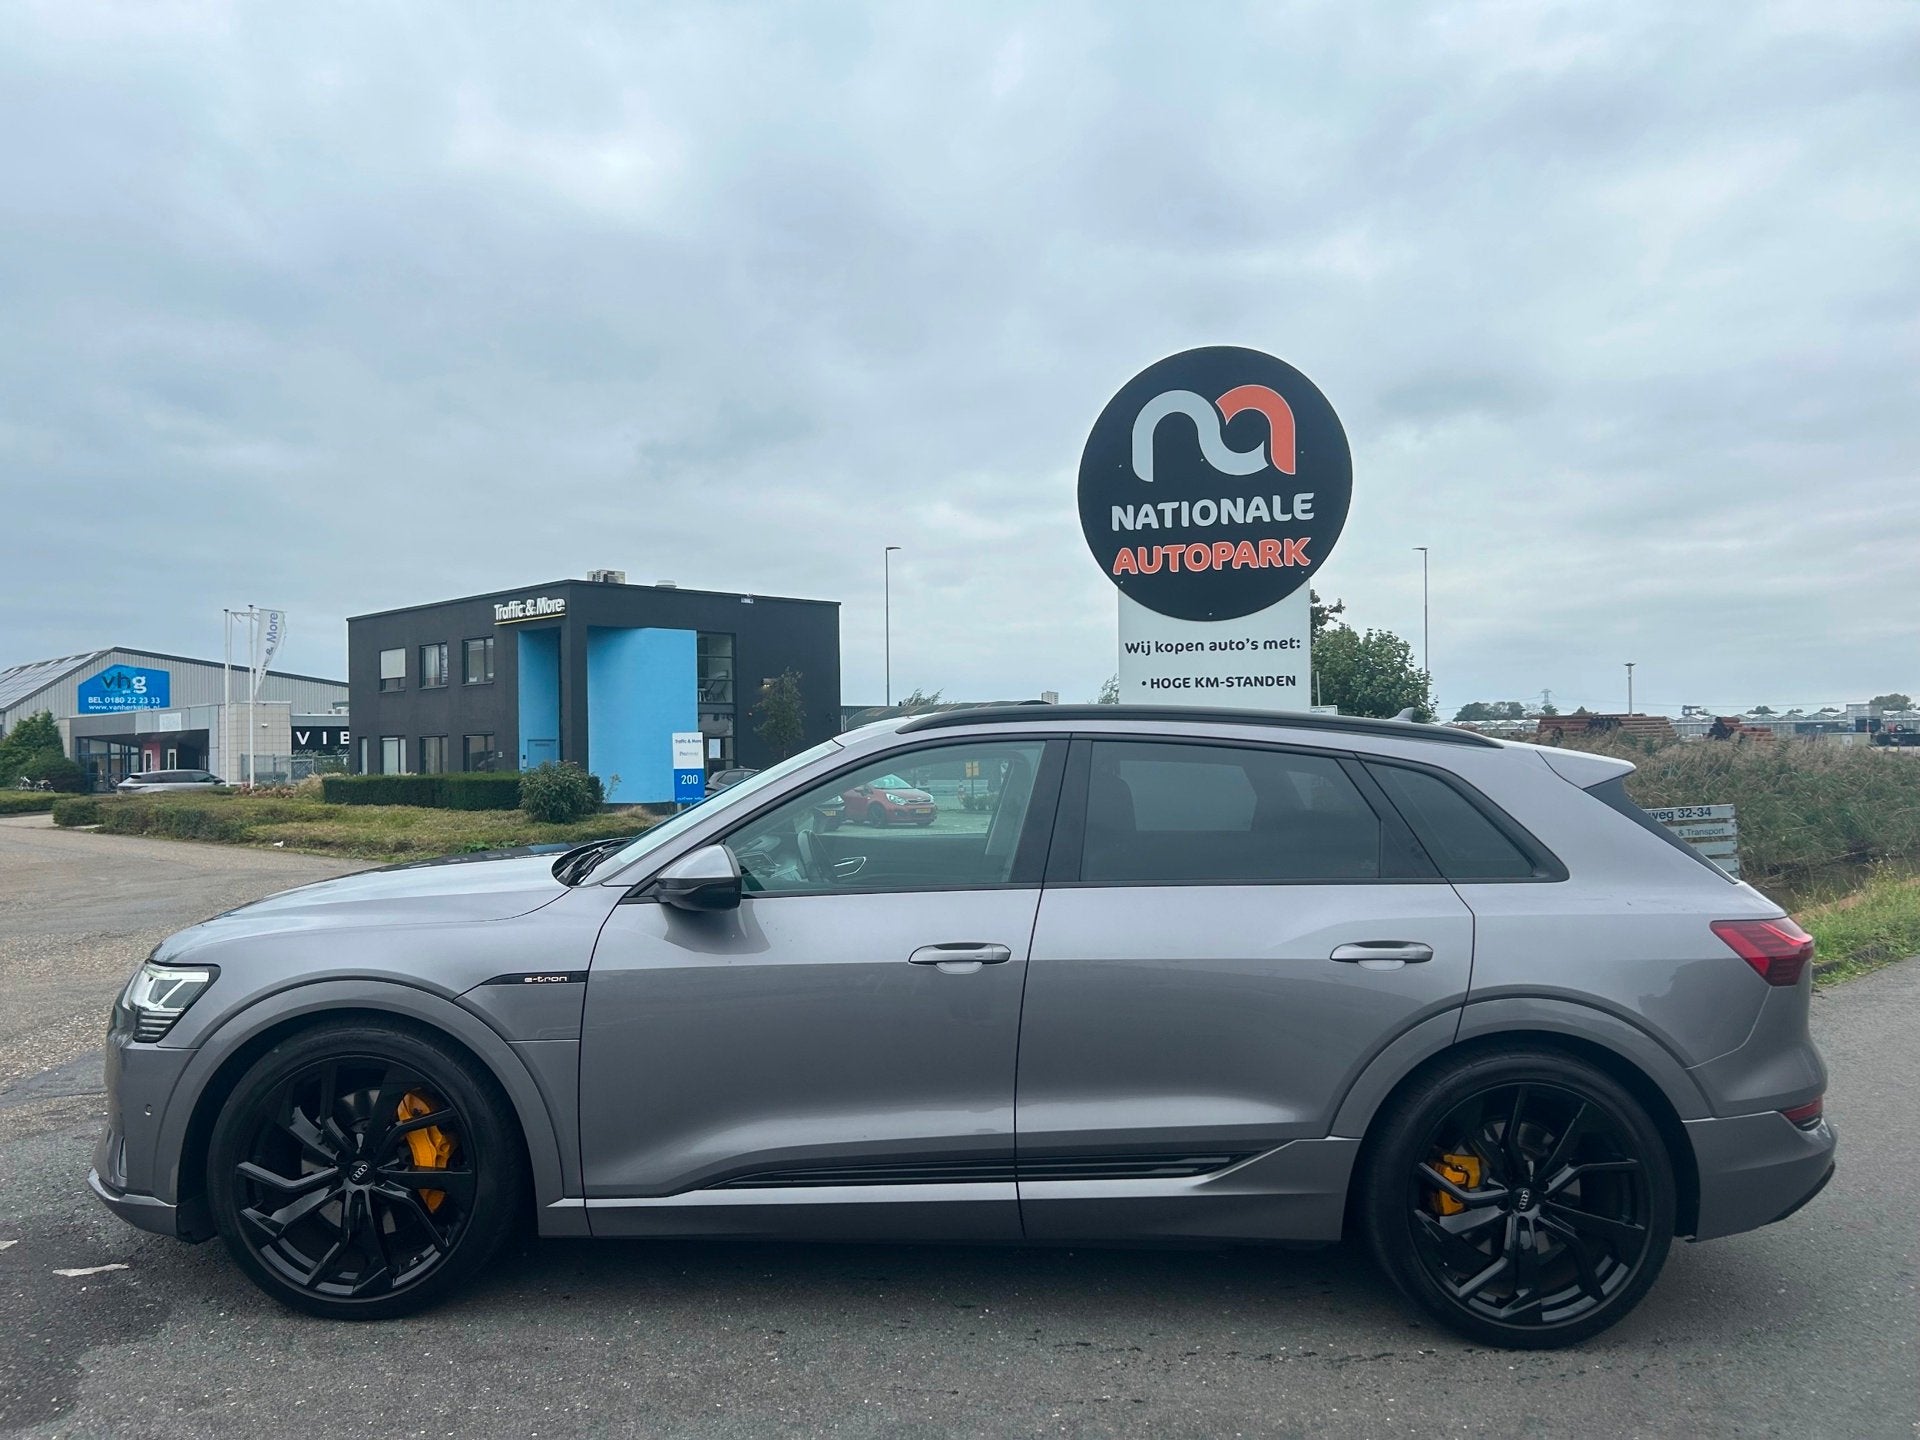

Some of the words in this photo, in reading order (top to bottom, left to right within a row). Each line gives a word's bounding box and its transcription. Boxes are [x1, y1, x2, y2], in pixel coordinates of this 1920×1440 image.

[1111, 492, 1315, 532] NATIONALE
[1113, 537, 1311, 576] AUTOPARK
[493, 600, 526, 621] Traffic
[525, 599, 537, 616] &
[536, 597, 566, 614] More
[266, 611, 279, 644] More
[1125, 641, 1151, 656] Wij
[1155, 641, 1204, 655] kopen
[1208, 638, 1259, 652] auto's
[1263, 637, 1301, 650] met:
[102, 671, 147, 694] vhg
[1151, 677, 1191, 689] HOGE
[1195, 675, 1296, 689] KM-STANDEN
[88, 696, 103, 704] BEL
[127, 696, 137, 704] 22
[681, 774, 698, 785] 200
[1678, 807, 1712, 819] 32-34
[1687, 827, 1725, 837] Transport
